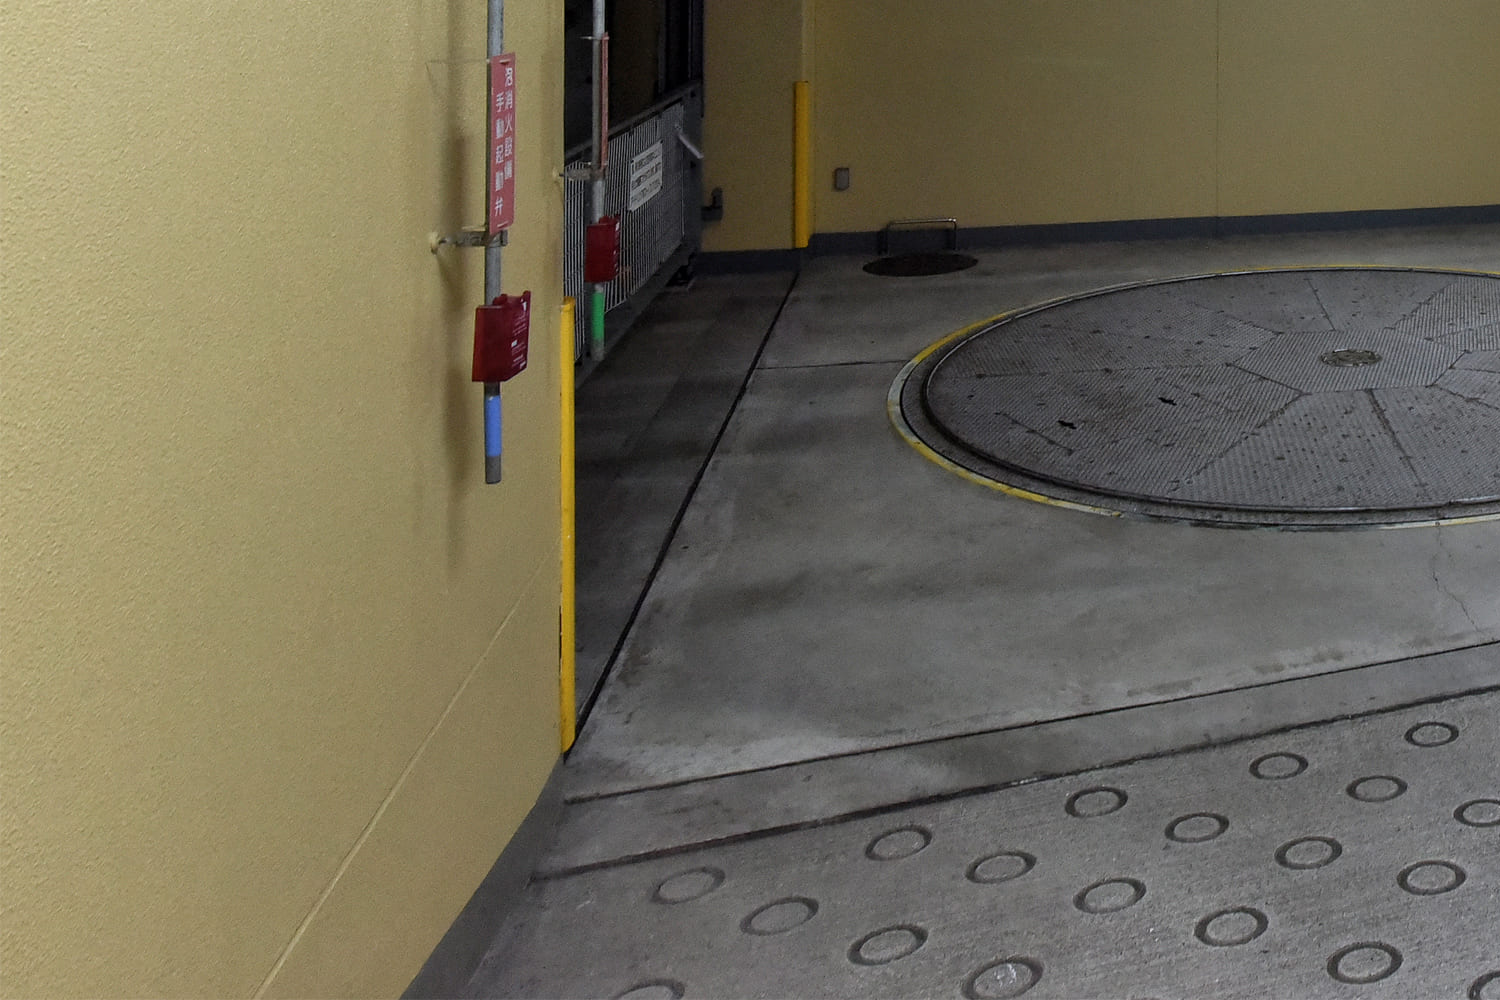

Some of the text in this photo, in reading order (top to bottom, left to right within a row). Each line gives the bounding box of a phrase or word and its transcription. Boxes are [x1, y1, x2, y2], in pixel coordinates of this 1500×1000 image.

[495, 92, 504, 217] 手動起動弁
[504, 67, 513, 180] 泡消火設備
